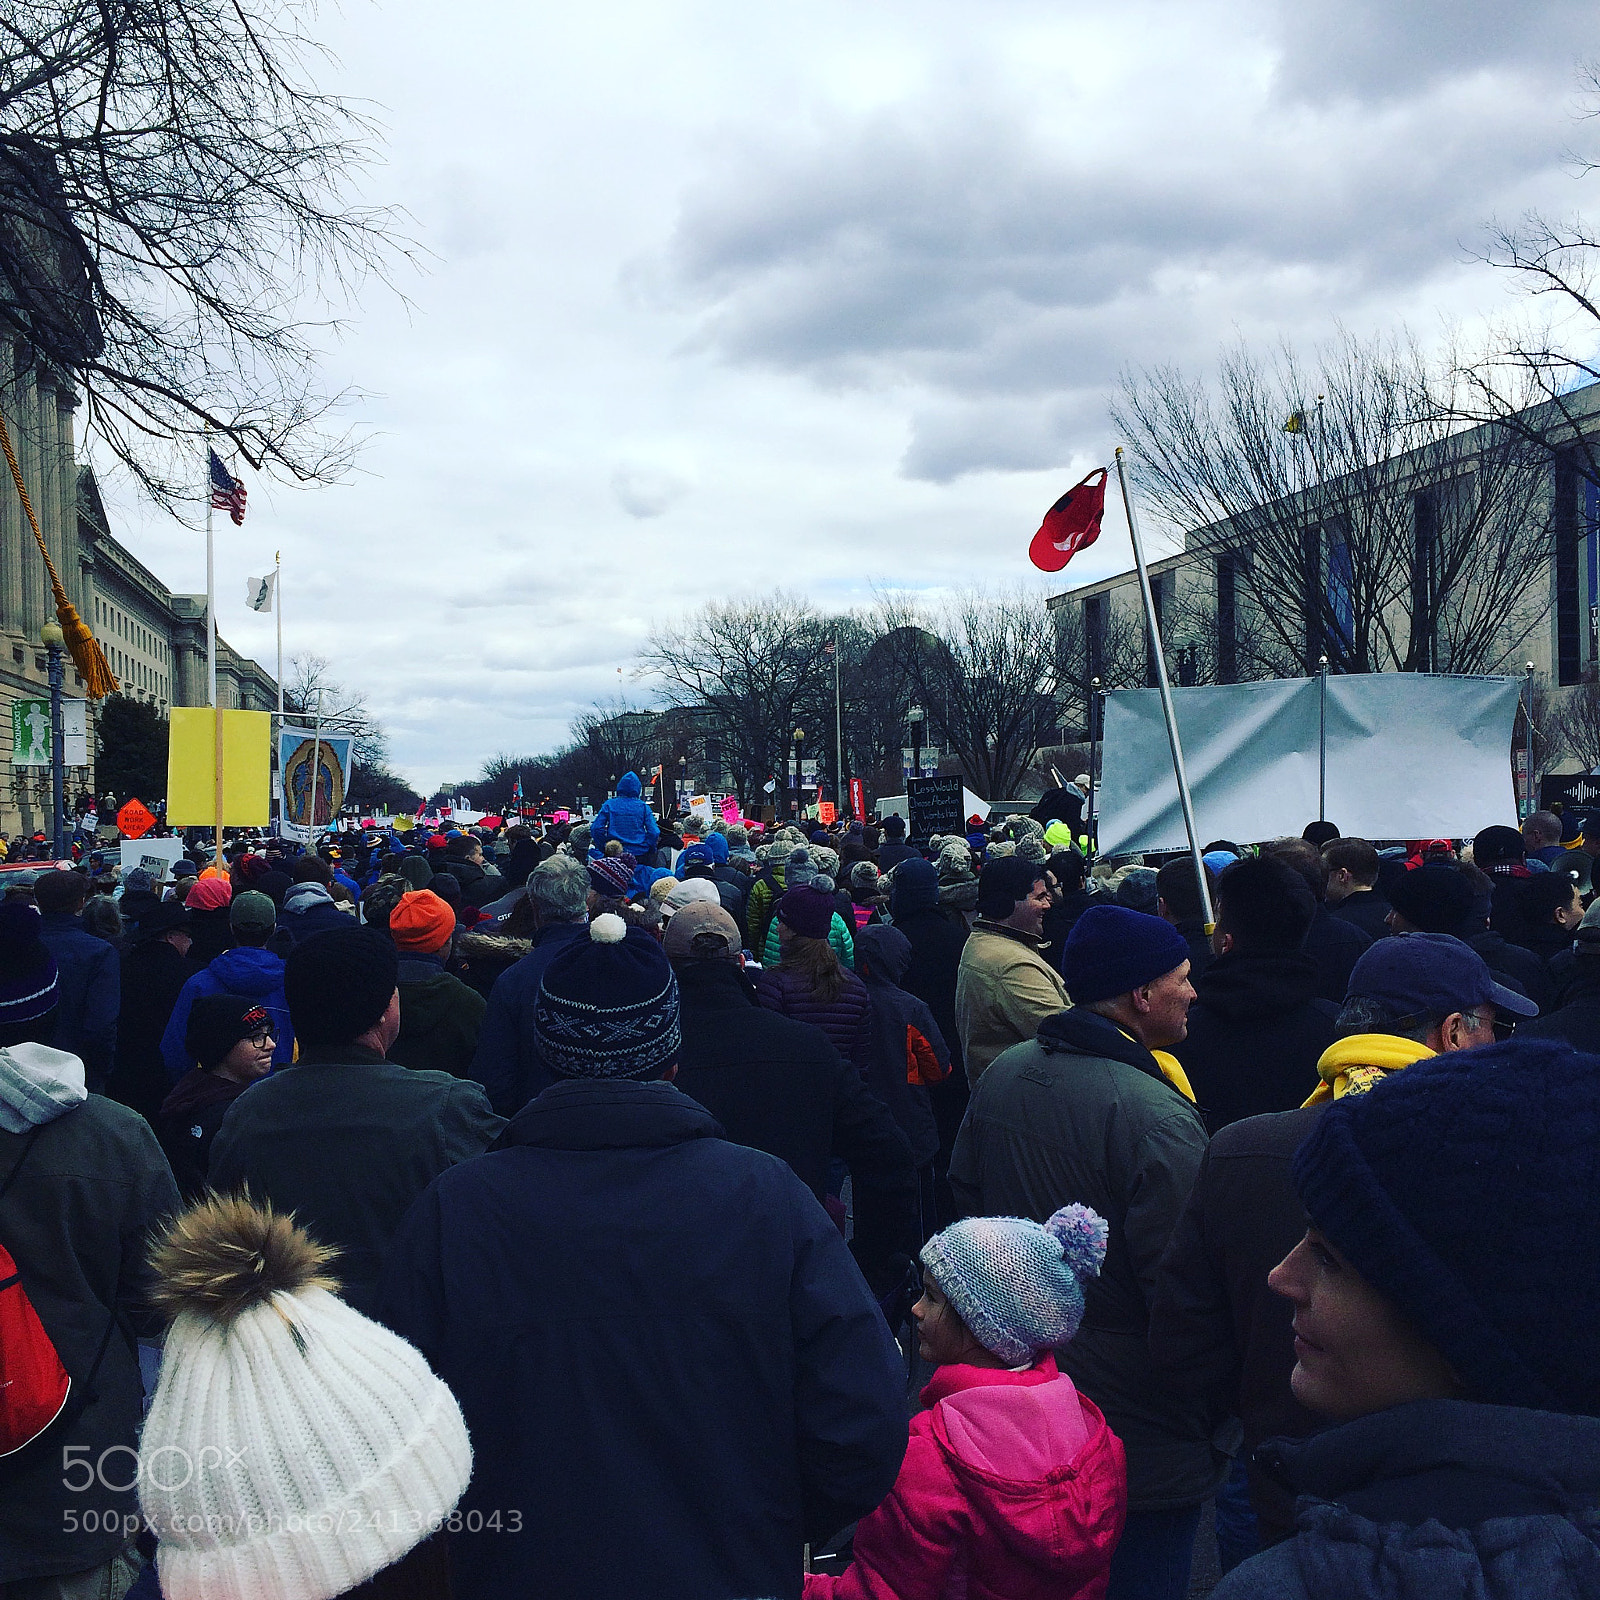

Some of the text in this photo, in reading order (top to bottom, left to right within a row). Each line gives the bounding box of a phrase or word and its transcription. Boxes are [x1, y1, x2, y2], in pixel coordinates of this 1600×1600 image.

[14, 710, 22, 751] DOWNTOWN
[913, 779, 959, 795] Less Would
[242, 1007, 267, 1024] TRU
